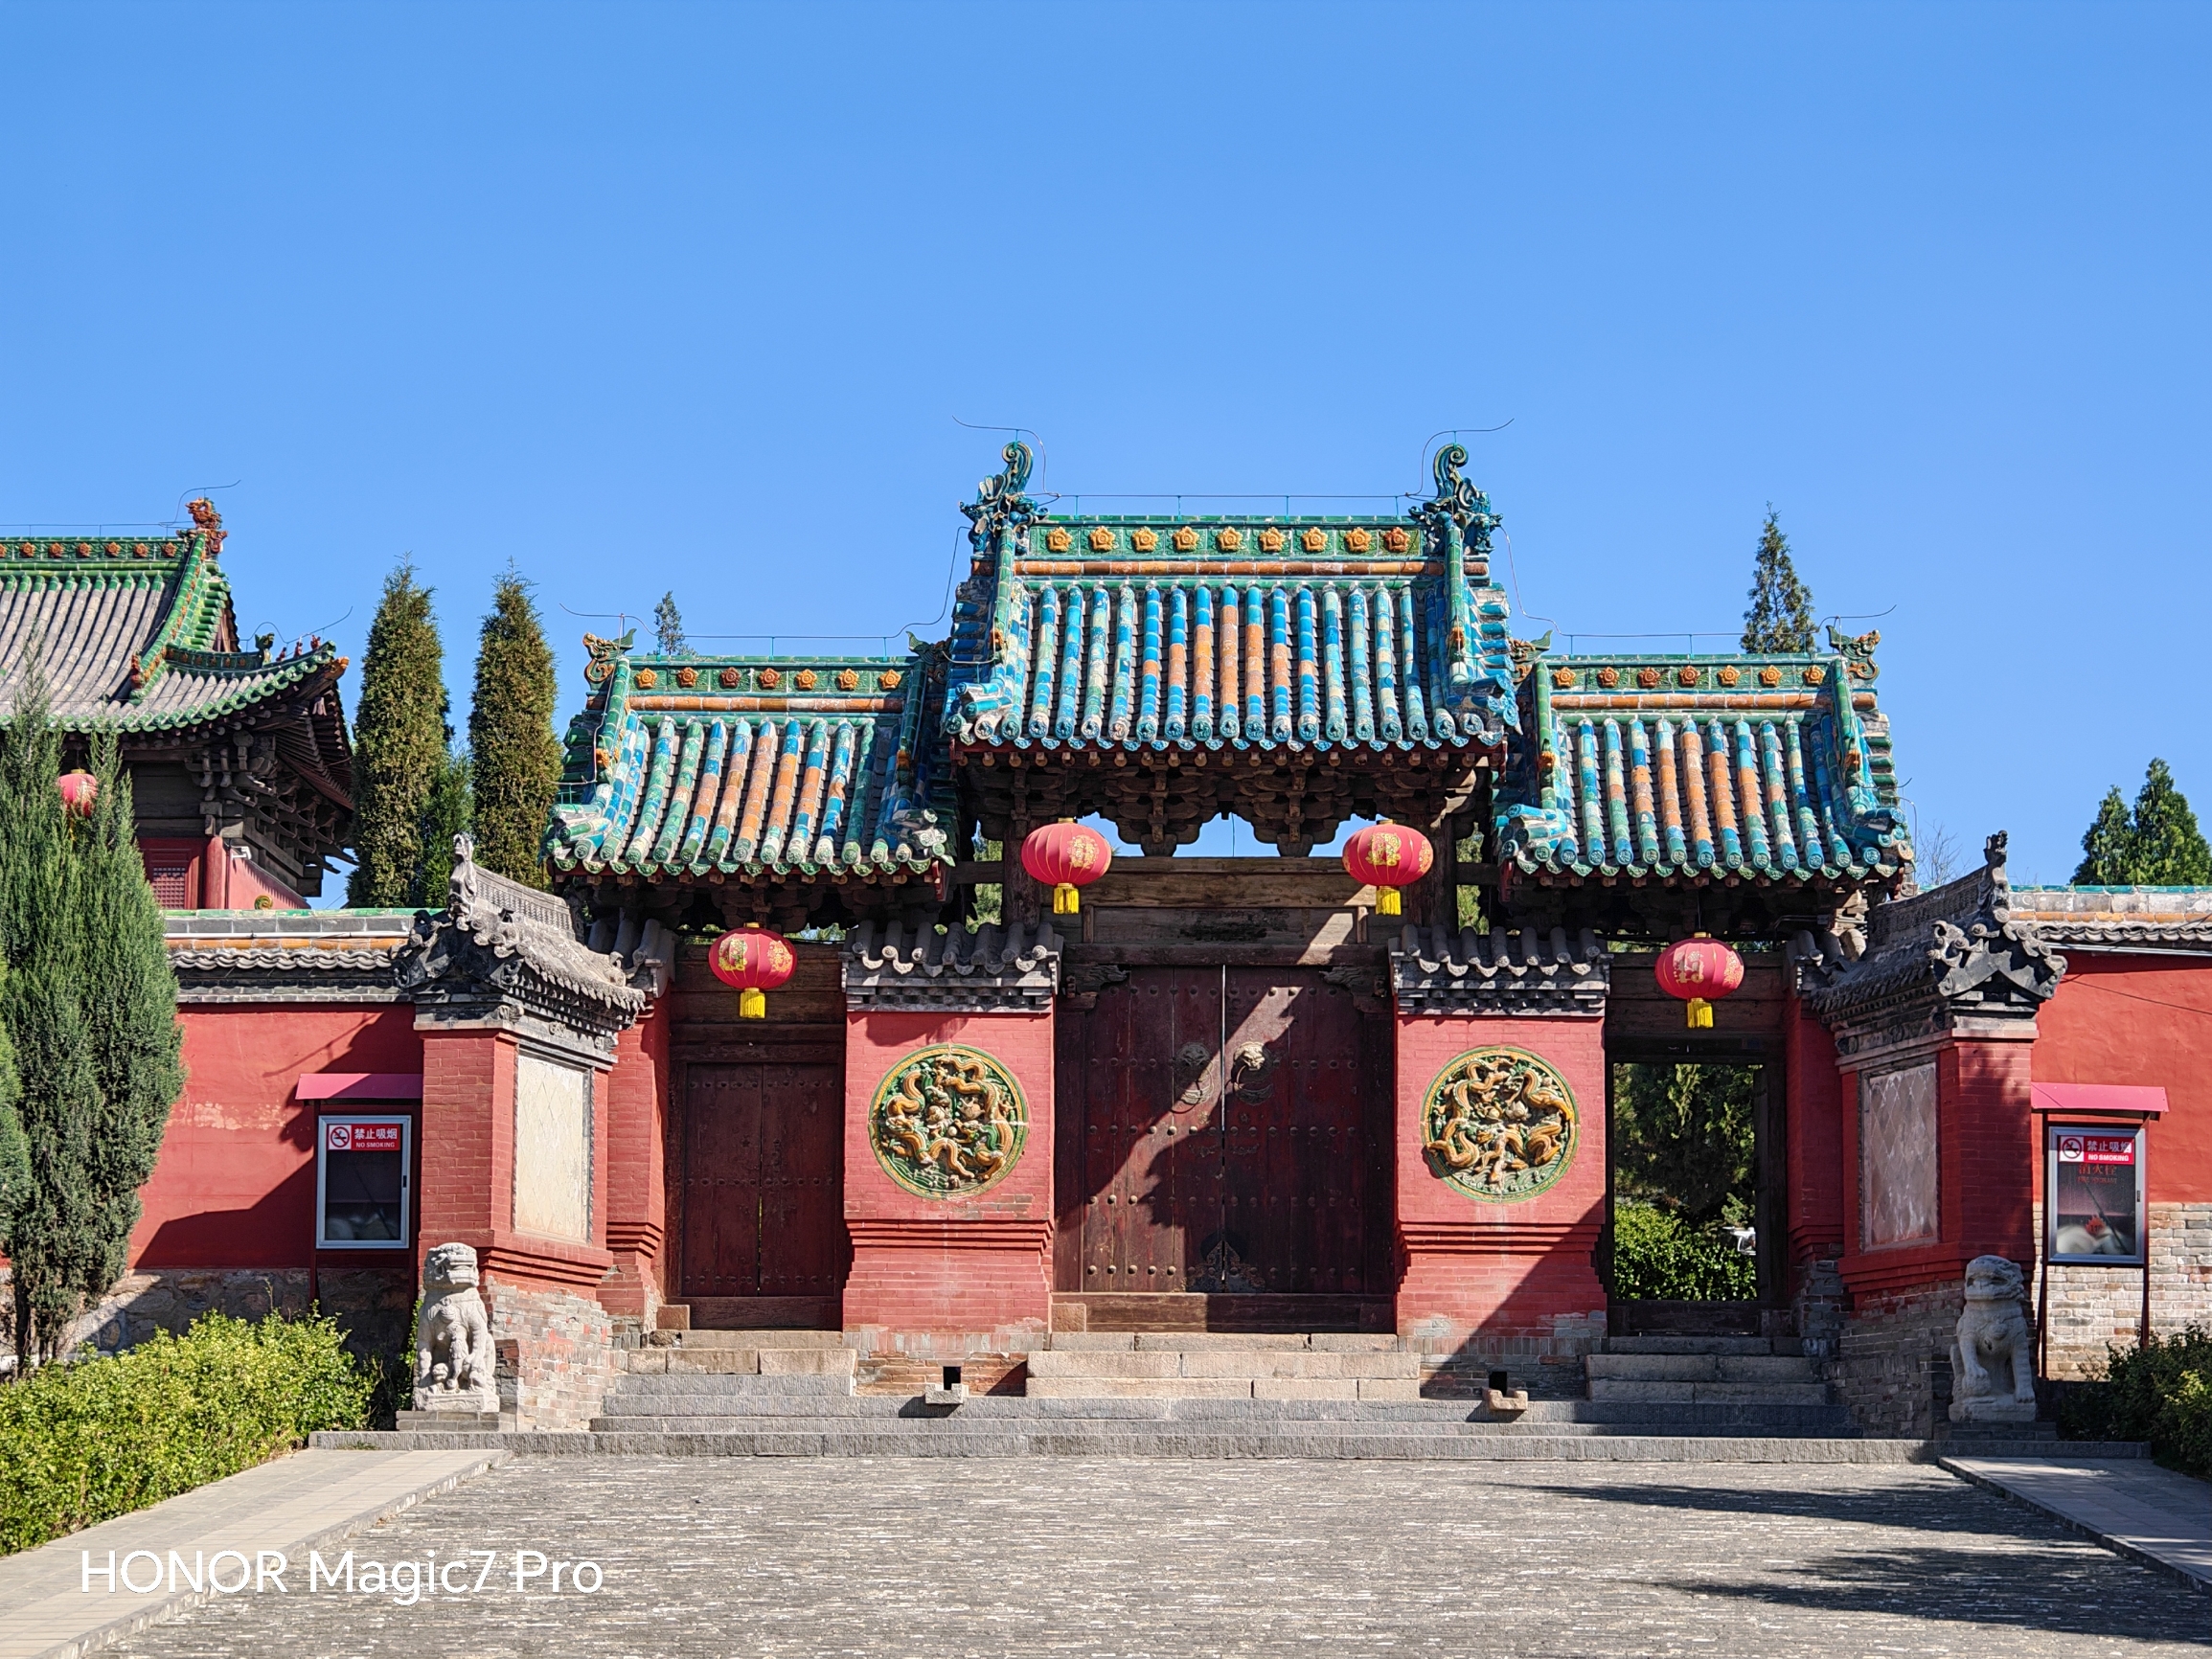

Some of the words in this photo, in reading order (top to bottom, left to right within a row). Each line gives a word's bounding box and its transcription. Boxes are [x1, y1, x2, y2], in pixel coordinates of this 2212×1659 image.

[354, 1128, 398, 1140] 禁止吸烟
[2087, 1141, 2132, 1153] 禁止吸烟
